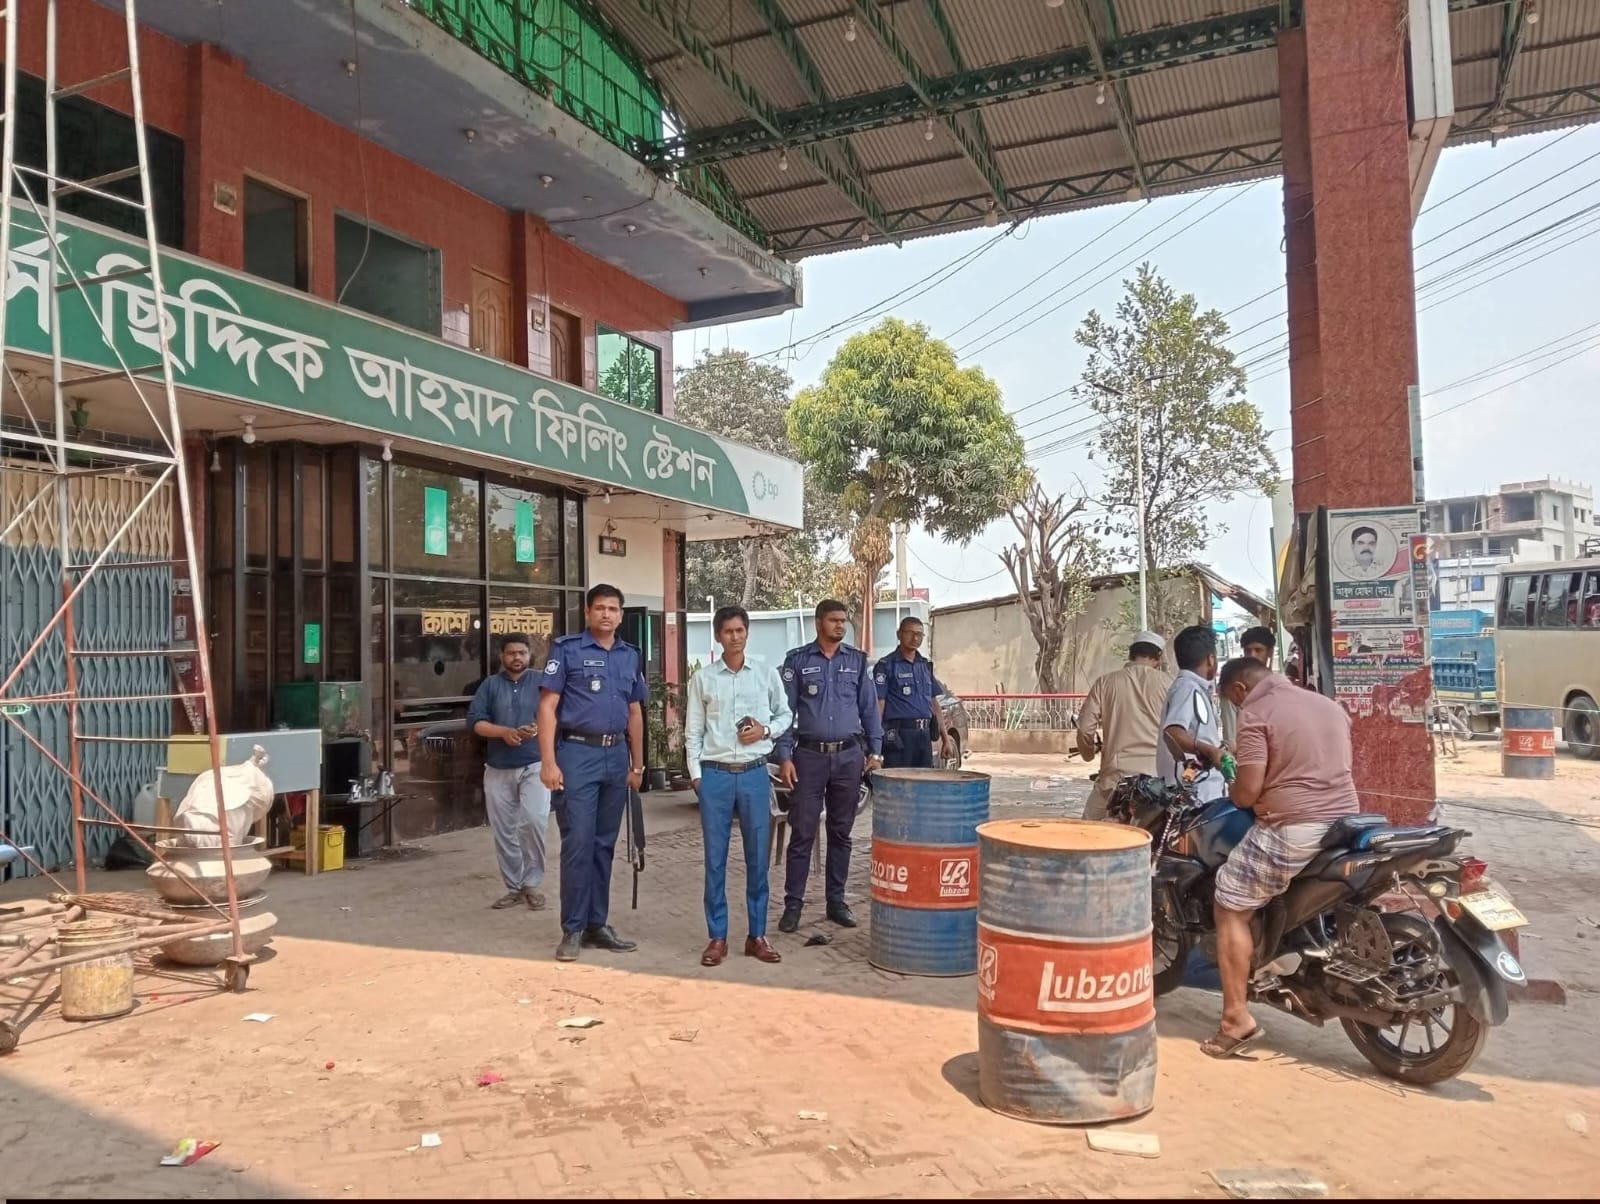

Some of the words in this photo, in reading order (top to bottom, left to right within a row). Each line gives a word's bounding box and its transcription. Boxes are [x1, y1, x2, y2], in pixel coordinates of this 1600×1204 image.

[343, 345, 519, 445] আহমদ
[527, 388, 632, 481] ফিলিং
[939, 886, 970, 897] Lubzone
[1037, 960, 1152, 1013] Lubzone
